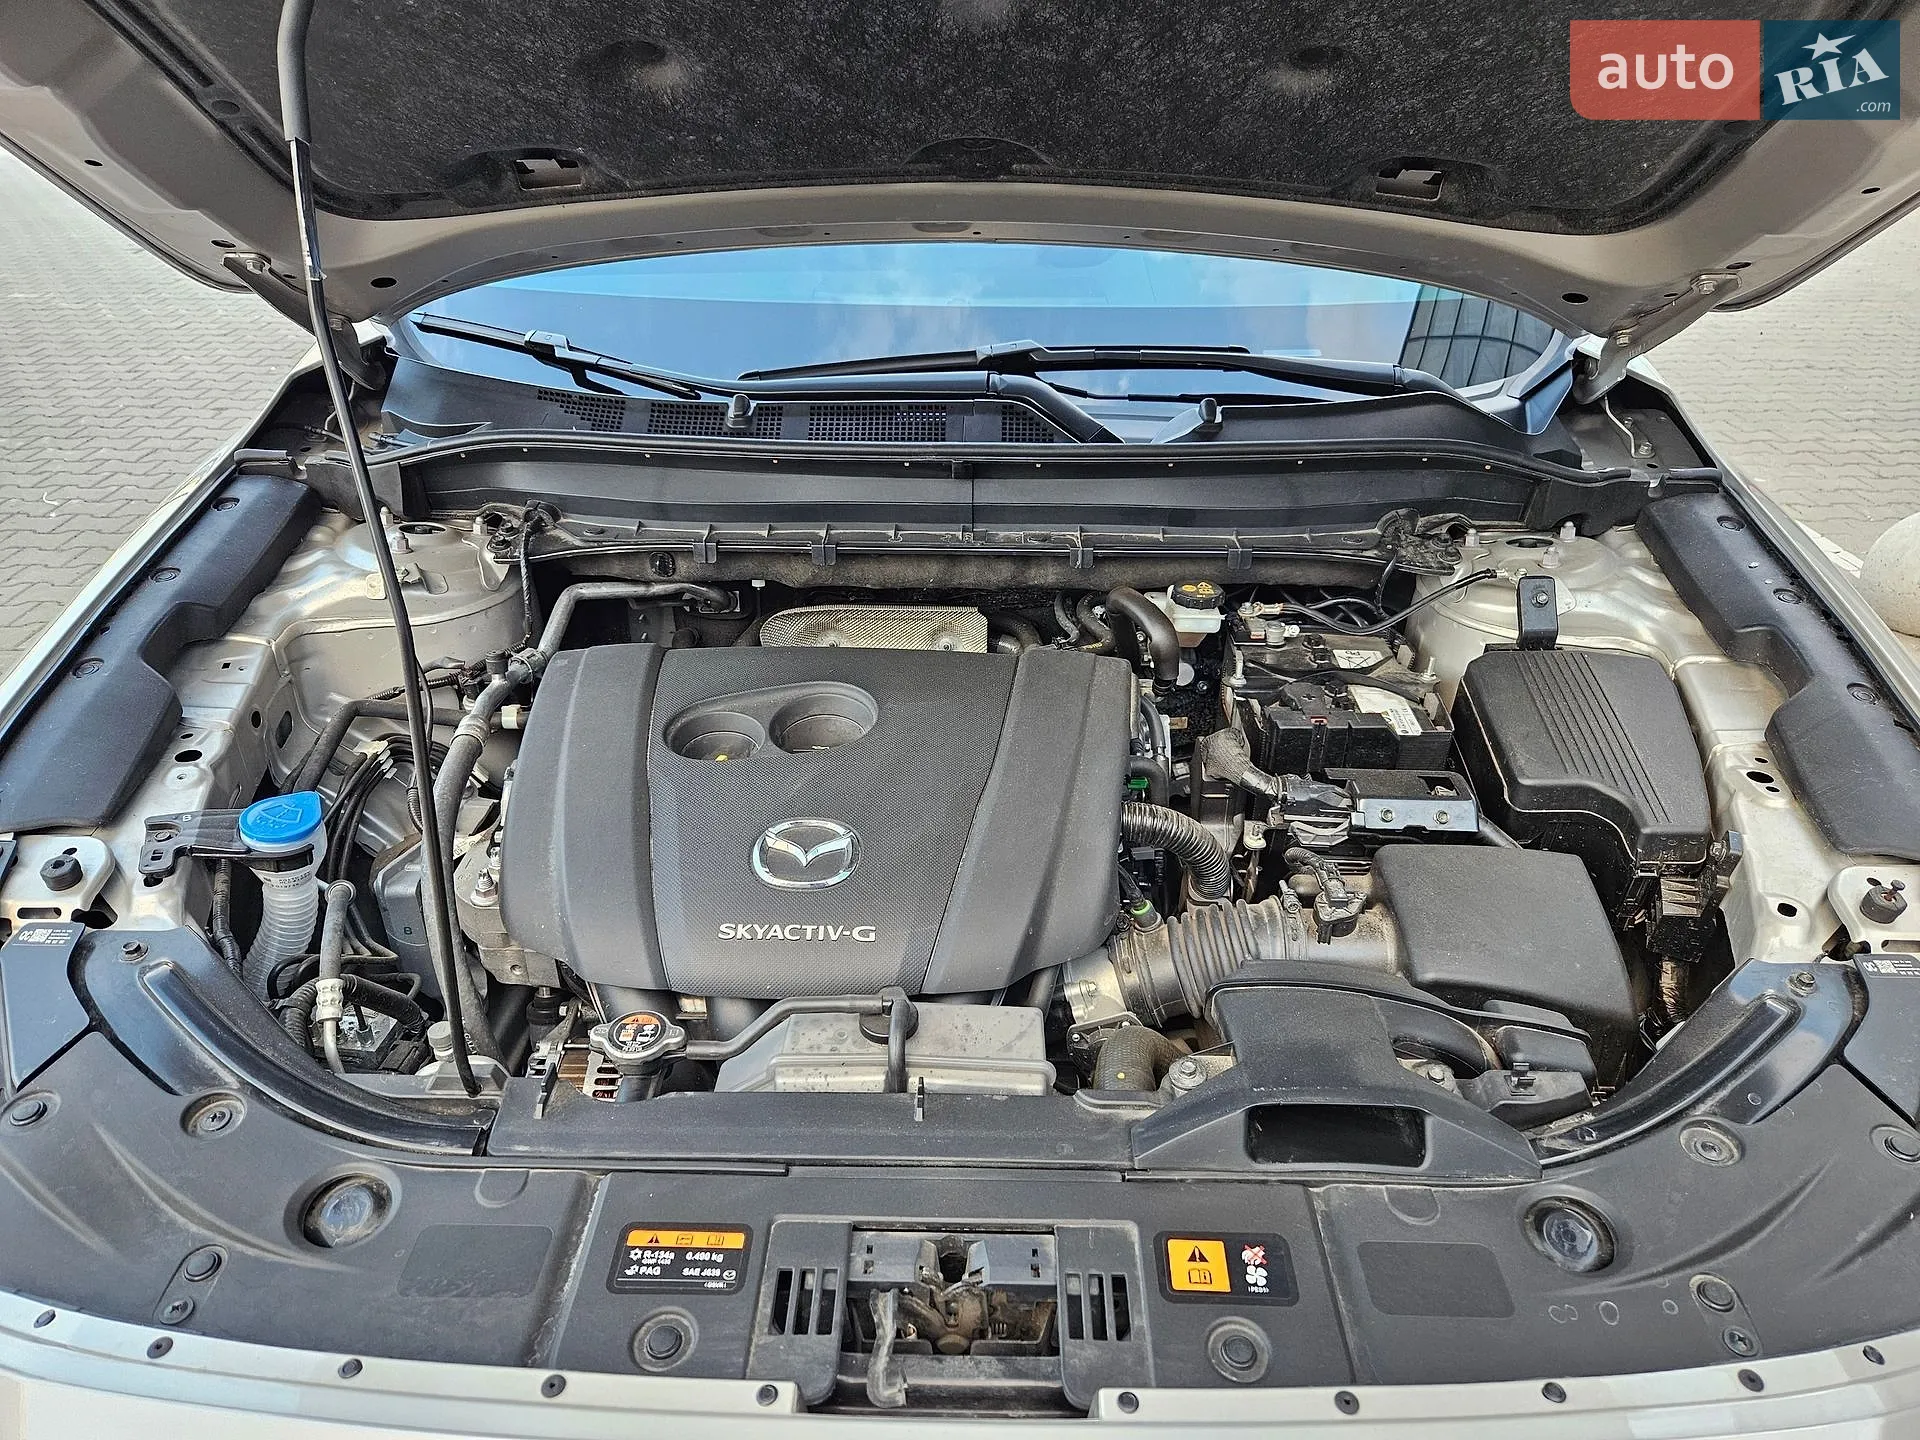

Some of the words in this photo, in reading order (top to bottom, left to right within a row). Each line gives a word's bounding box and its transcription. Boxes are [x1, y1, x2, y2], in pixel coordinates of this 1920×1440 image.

[718, 923, 877, 943] SKYACTIV-G
[643, 1249, 675, 1260] R-134a
[711, 1251, 724, 1263] kg
[639, 1266, 661, 1276] PAG
[681, 1267, 700, 1277] SAE
